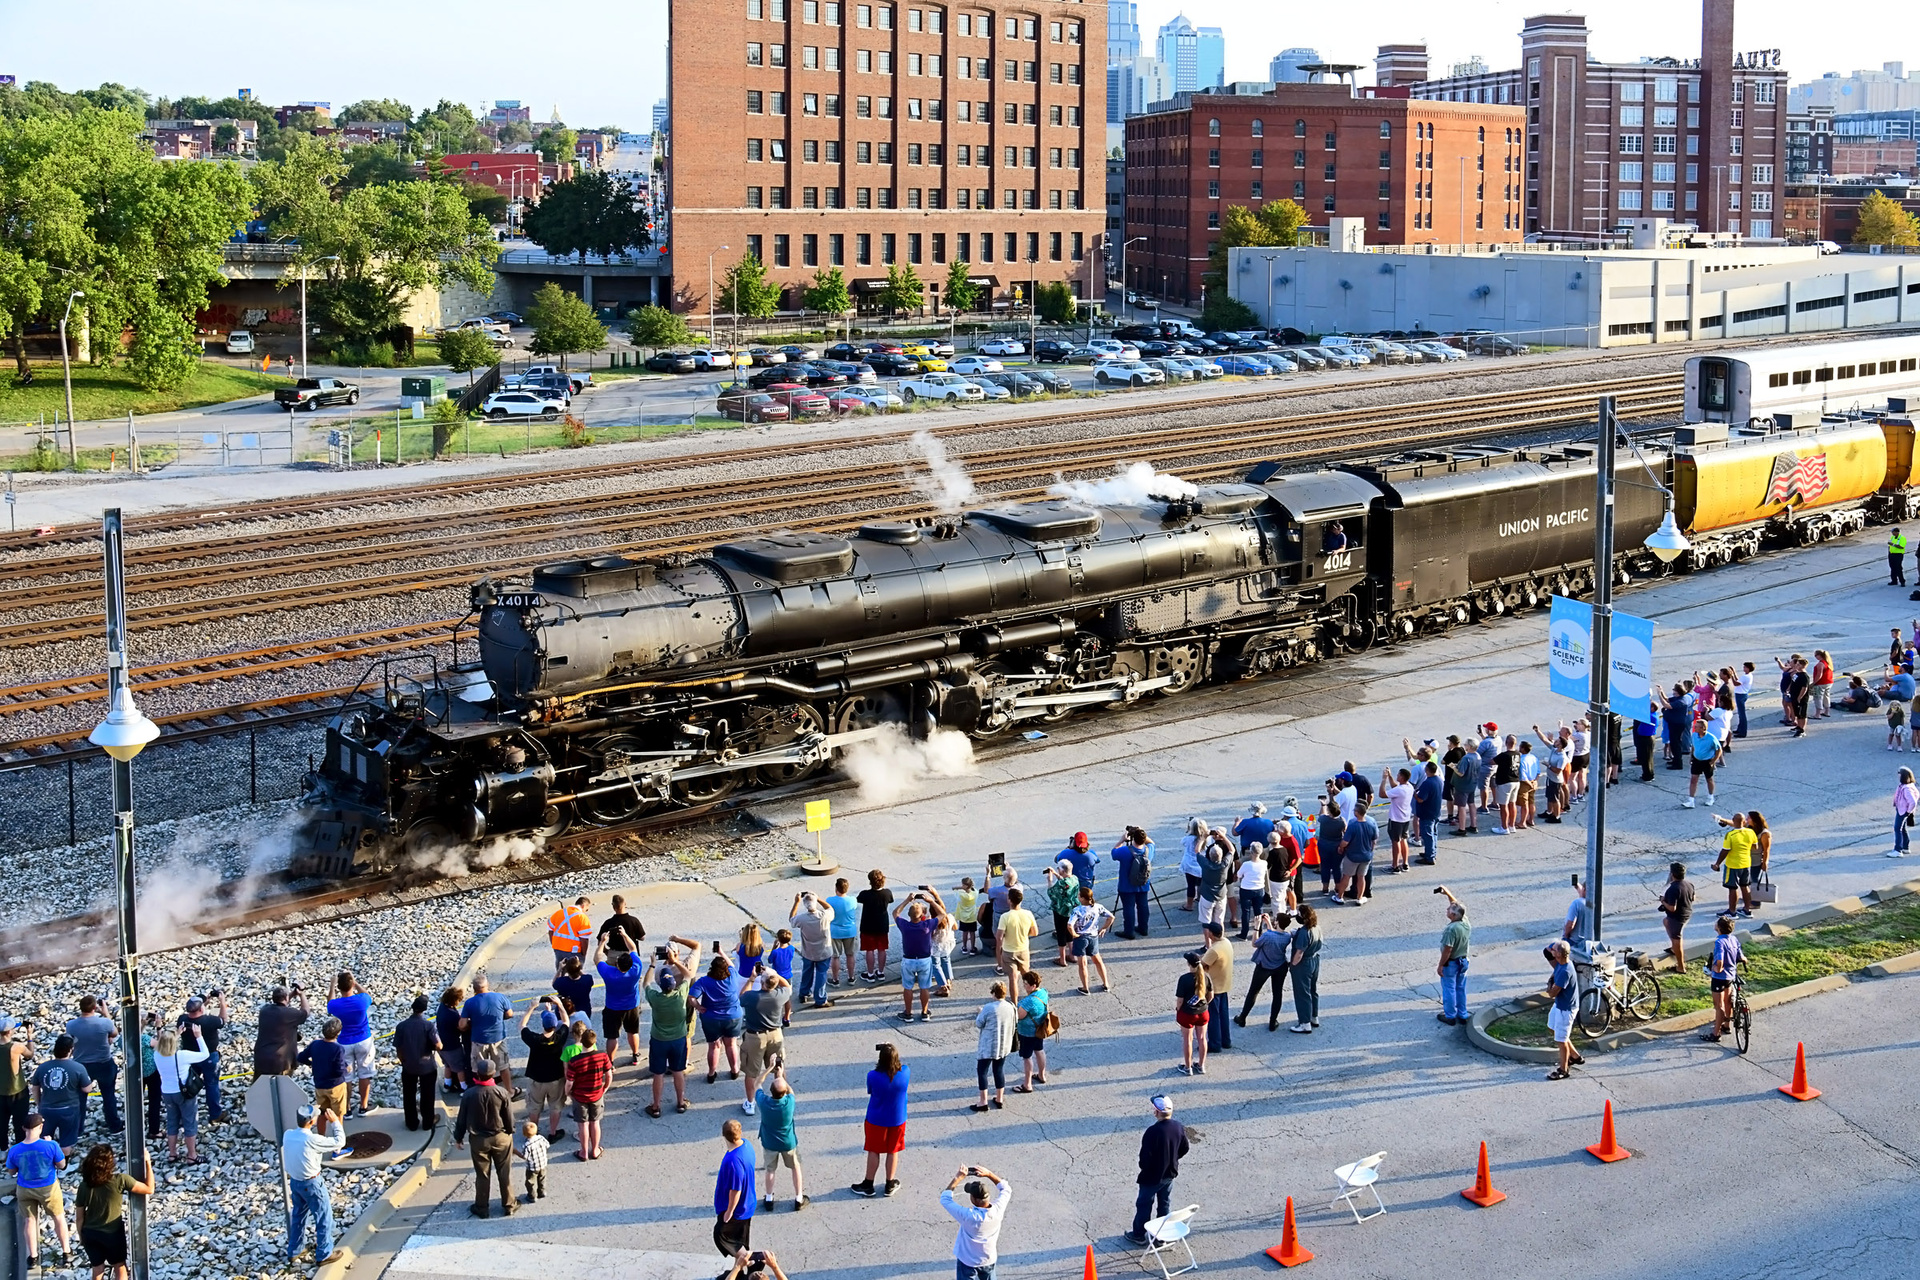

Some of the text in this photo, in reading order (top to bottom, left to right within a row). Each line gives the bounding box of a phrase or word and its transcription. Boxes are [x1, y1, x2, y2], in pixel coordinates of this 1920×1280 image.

[1499, 508, 1589, 538] UNION PACIFIC
[1323, 552, 1352, 570] 4014
[497, 595, 540, 606] X4014
[1552, 649, 1585, 665] SCIENCE
[1561, 658, 1576, 667] CITY
[1617, 661, 1633, 670] BURNS
